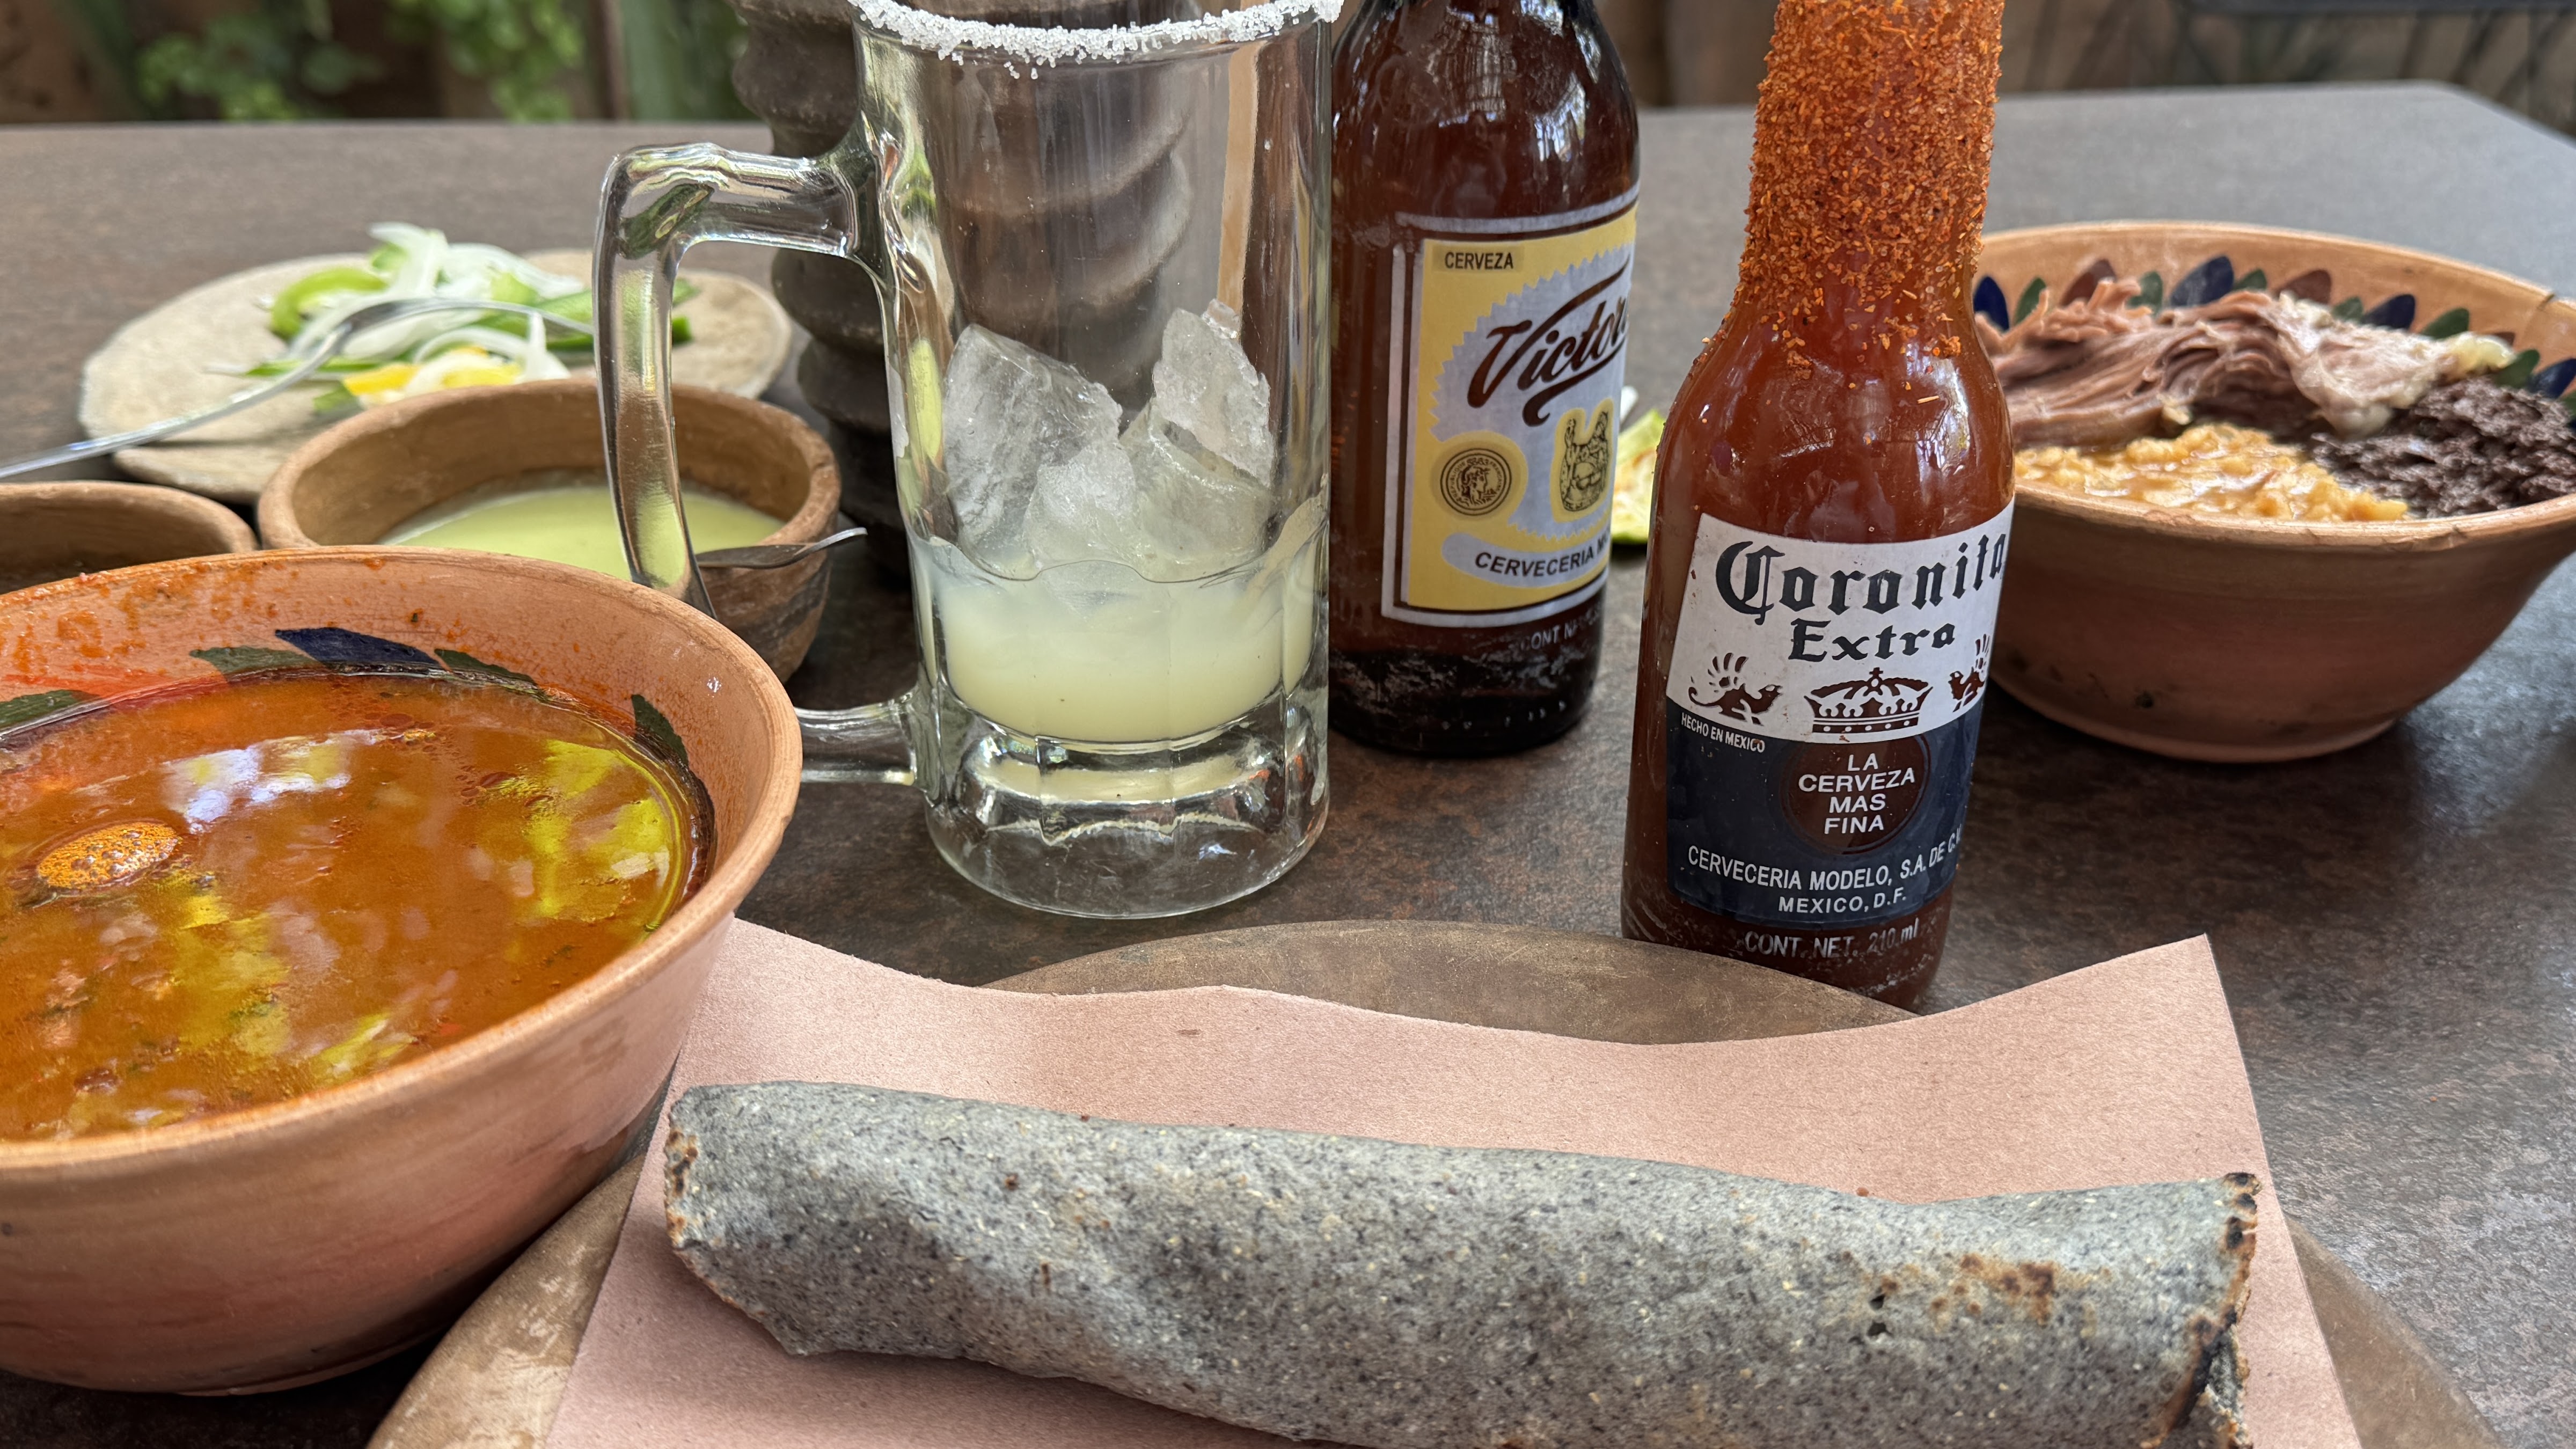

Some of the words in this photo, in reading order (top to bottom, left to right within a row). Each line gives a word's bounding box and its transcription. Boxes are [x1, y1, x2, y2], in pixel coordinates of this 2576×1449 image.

[1445, 252, 1513, 269] CERVEZA
[1475, 546, 1593, 577] CERVECERIA
[1715, 533, 2007, 626] Coronita
[1788, 618, 1955, 662] Extra
[1681, 712, 1709, 737] HECHO
[1710, 726, 1723, 743] EN
[1725, 731, 1766, 753] MEXICO
[1847, 752, 1879, 772] LA
[1798, 767, 1915, 793] CERVEZA
[1828, 793, 1886, 814] MAS
[1824, 814, 1884, 835] FINA
[1688, 845, 1802, 890] CERVECERIA
[1809, 865, 1892, 891] MODELO,
[1900, 854, 1927, 879] S.A.
[1929, 841, 1946, 868] DE
